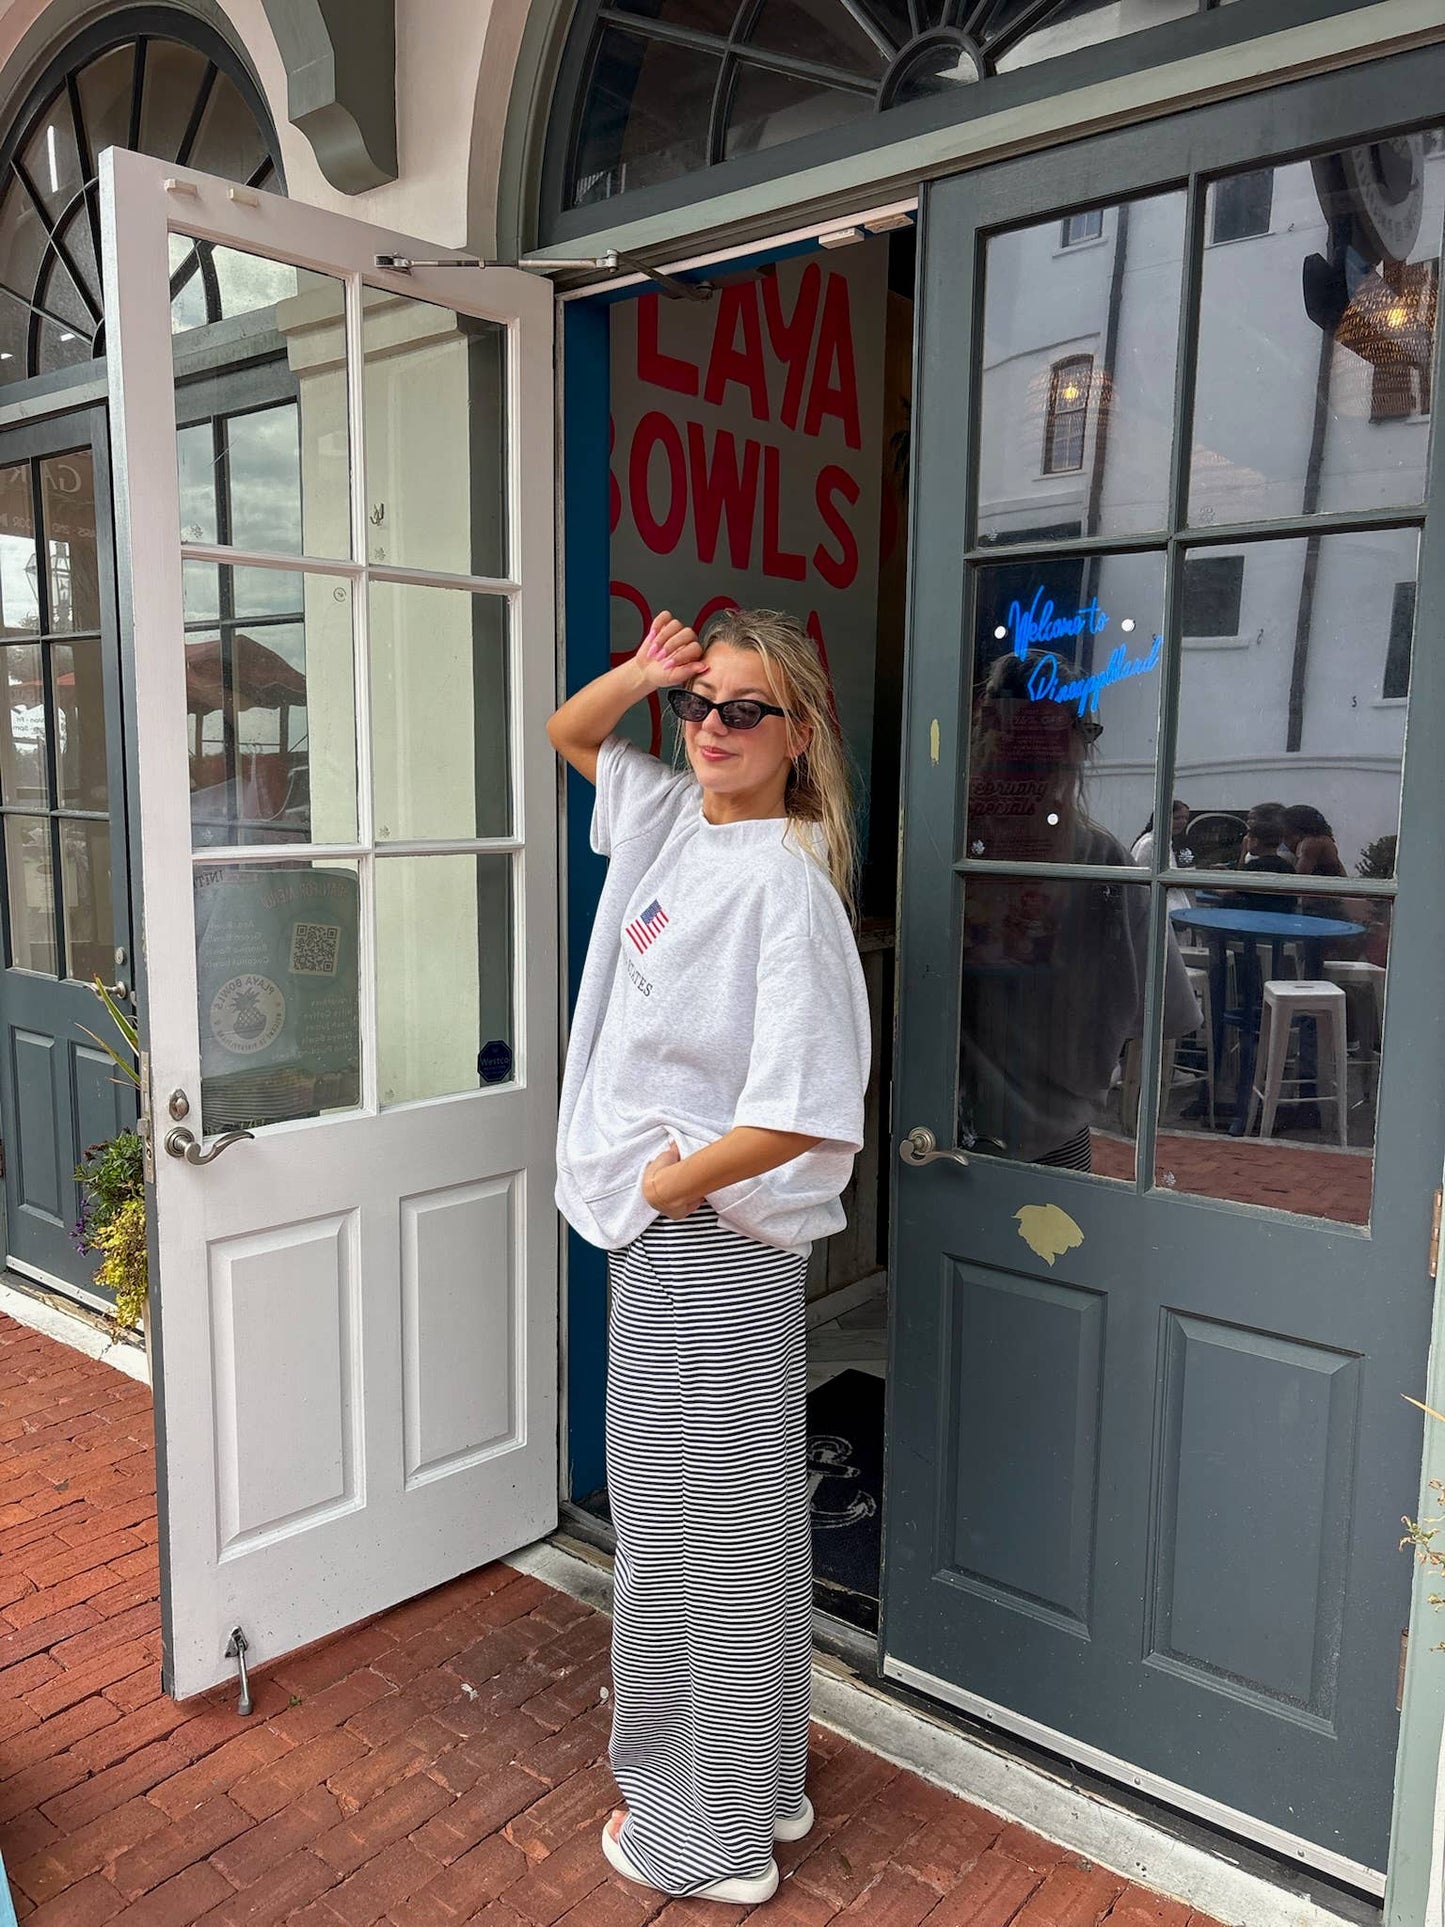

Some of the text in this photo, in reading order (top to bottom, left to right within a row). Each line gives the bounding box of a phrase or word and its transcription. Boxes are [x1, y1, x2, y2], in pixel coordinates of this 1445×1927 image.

[609, 411, 860, 589] OWLS
[1008, 585, 1109, 661] Welcome to
[970, 778, 1048, 803] ebruary
[970, 797, 1036, 820] pecials
[625, 959, 653, 997] TATES
